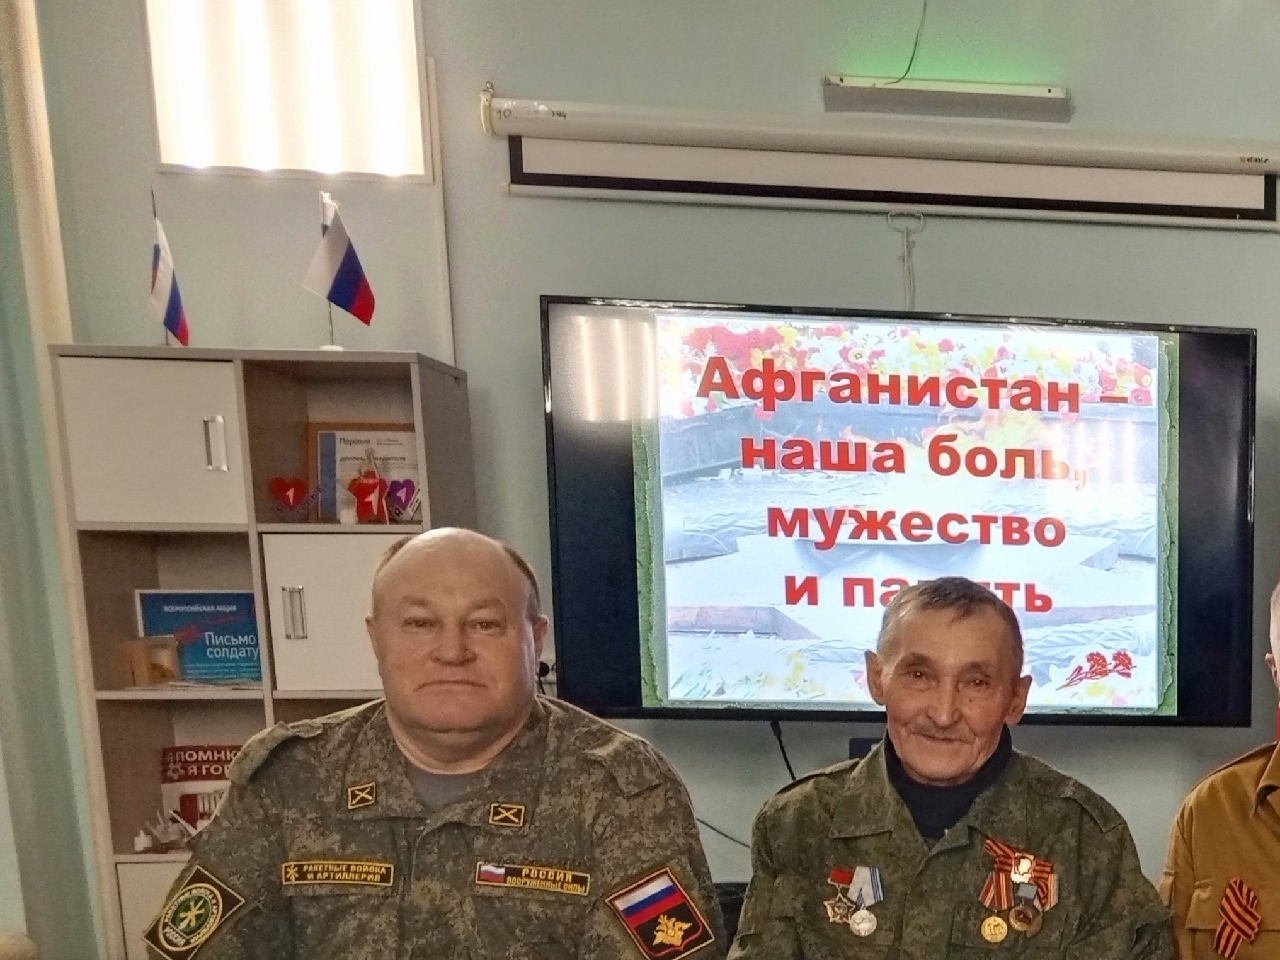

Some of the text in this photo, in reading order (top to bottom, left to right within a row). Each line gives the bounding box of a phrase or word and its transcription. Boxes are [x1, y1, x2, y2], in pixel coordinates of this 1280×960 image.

[696, 355, 1081, 413] Афганистан
[741, 433, 1088, 490] наша боль,
[767, 506, 1067, 549] мужество
[784, 575, 1053, 613] и пать
[204, 631, 256, 645] Письмо
[206, 647, 259, 660] солдату
[187, 765, 198, 775] Я
[303, 864, 386, 875] РАКЕТНЫЕ ВОЙСКА
[521, 868, 573, 882] РОССИЯ
[316, 872, 381, 882] АРТИЛЛЕРИЯ
[506, 875, 561, 891] ВООРУЖЕННЫЕ
